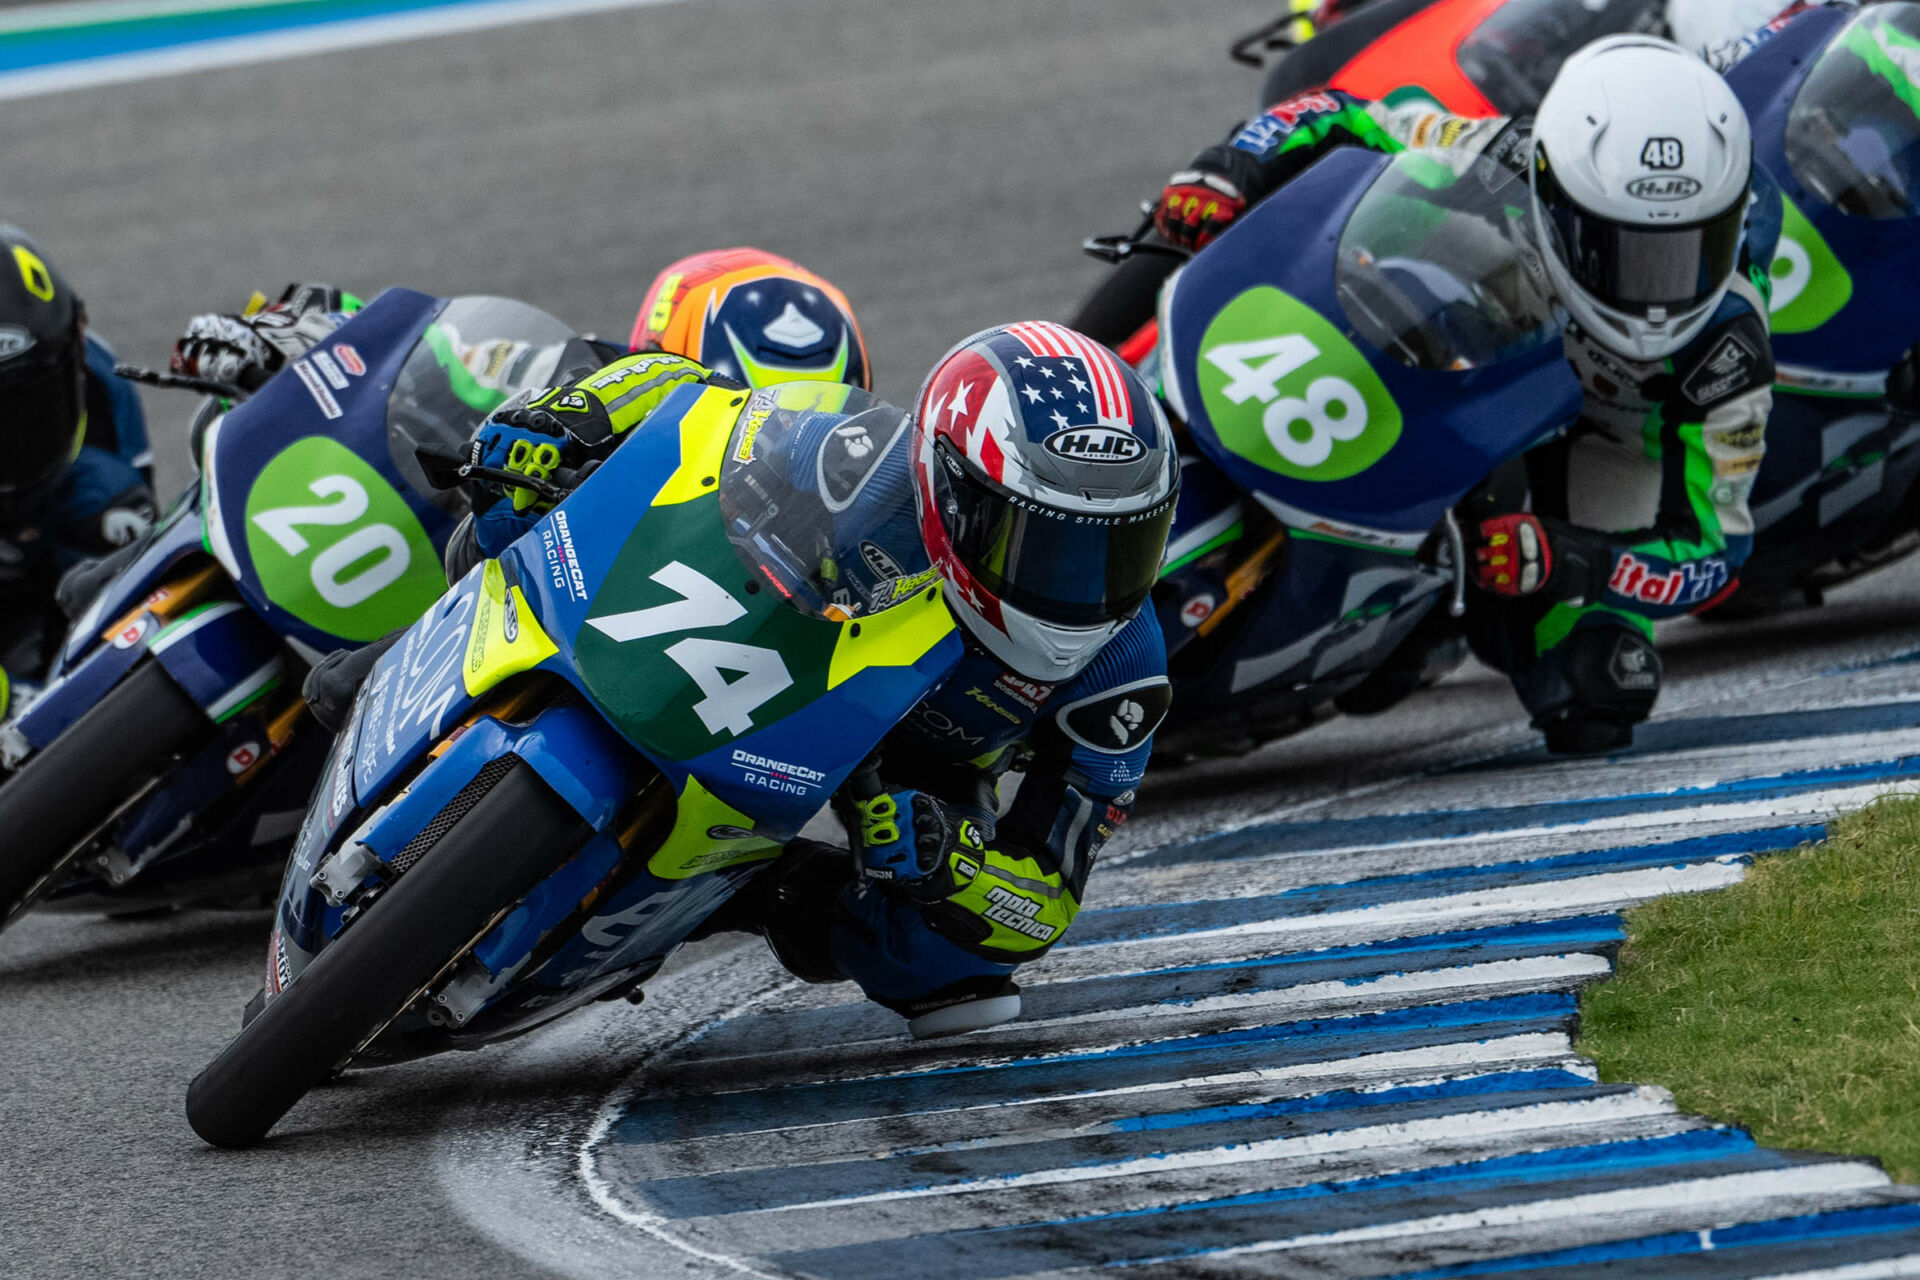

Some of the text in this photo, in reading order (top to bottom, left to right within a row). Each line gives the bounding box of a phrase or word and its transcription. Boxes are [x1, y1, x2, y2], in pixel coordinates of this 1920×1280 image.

[1641, 137, 1683, 170] 48
[1634, 180, 1693, 196] HJC
[1204, 333, 1369, 468] 48
[1059, 434, 1137, 457] HJC
[1008, 496, 1171, 526] RACING STYLE MAKERS
[251, 474, 412, 608] 20
[542, 531, 565, 589] RACING
[585, 560, 795, 737] 74
[731, 749, 826, 782] ORANGECAT
[744, 771, 808, 797] RACING
[985, 886, 1043, 916] moto
